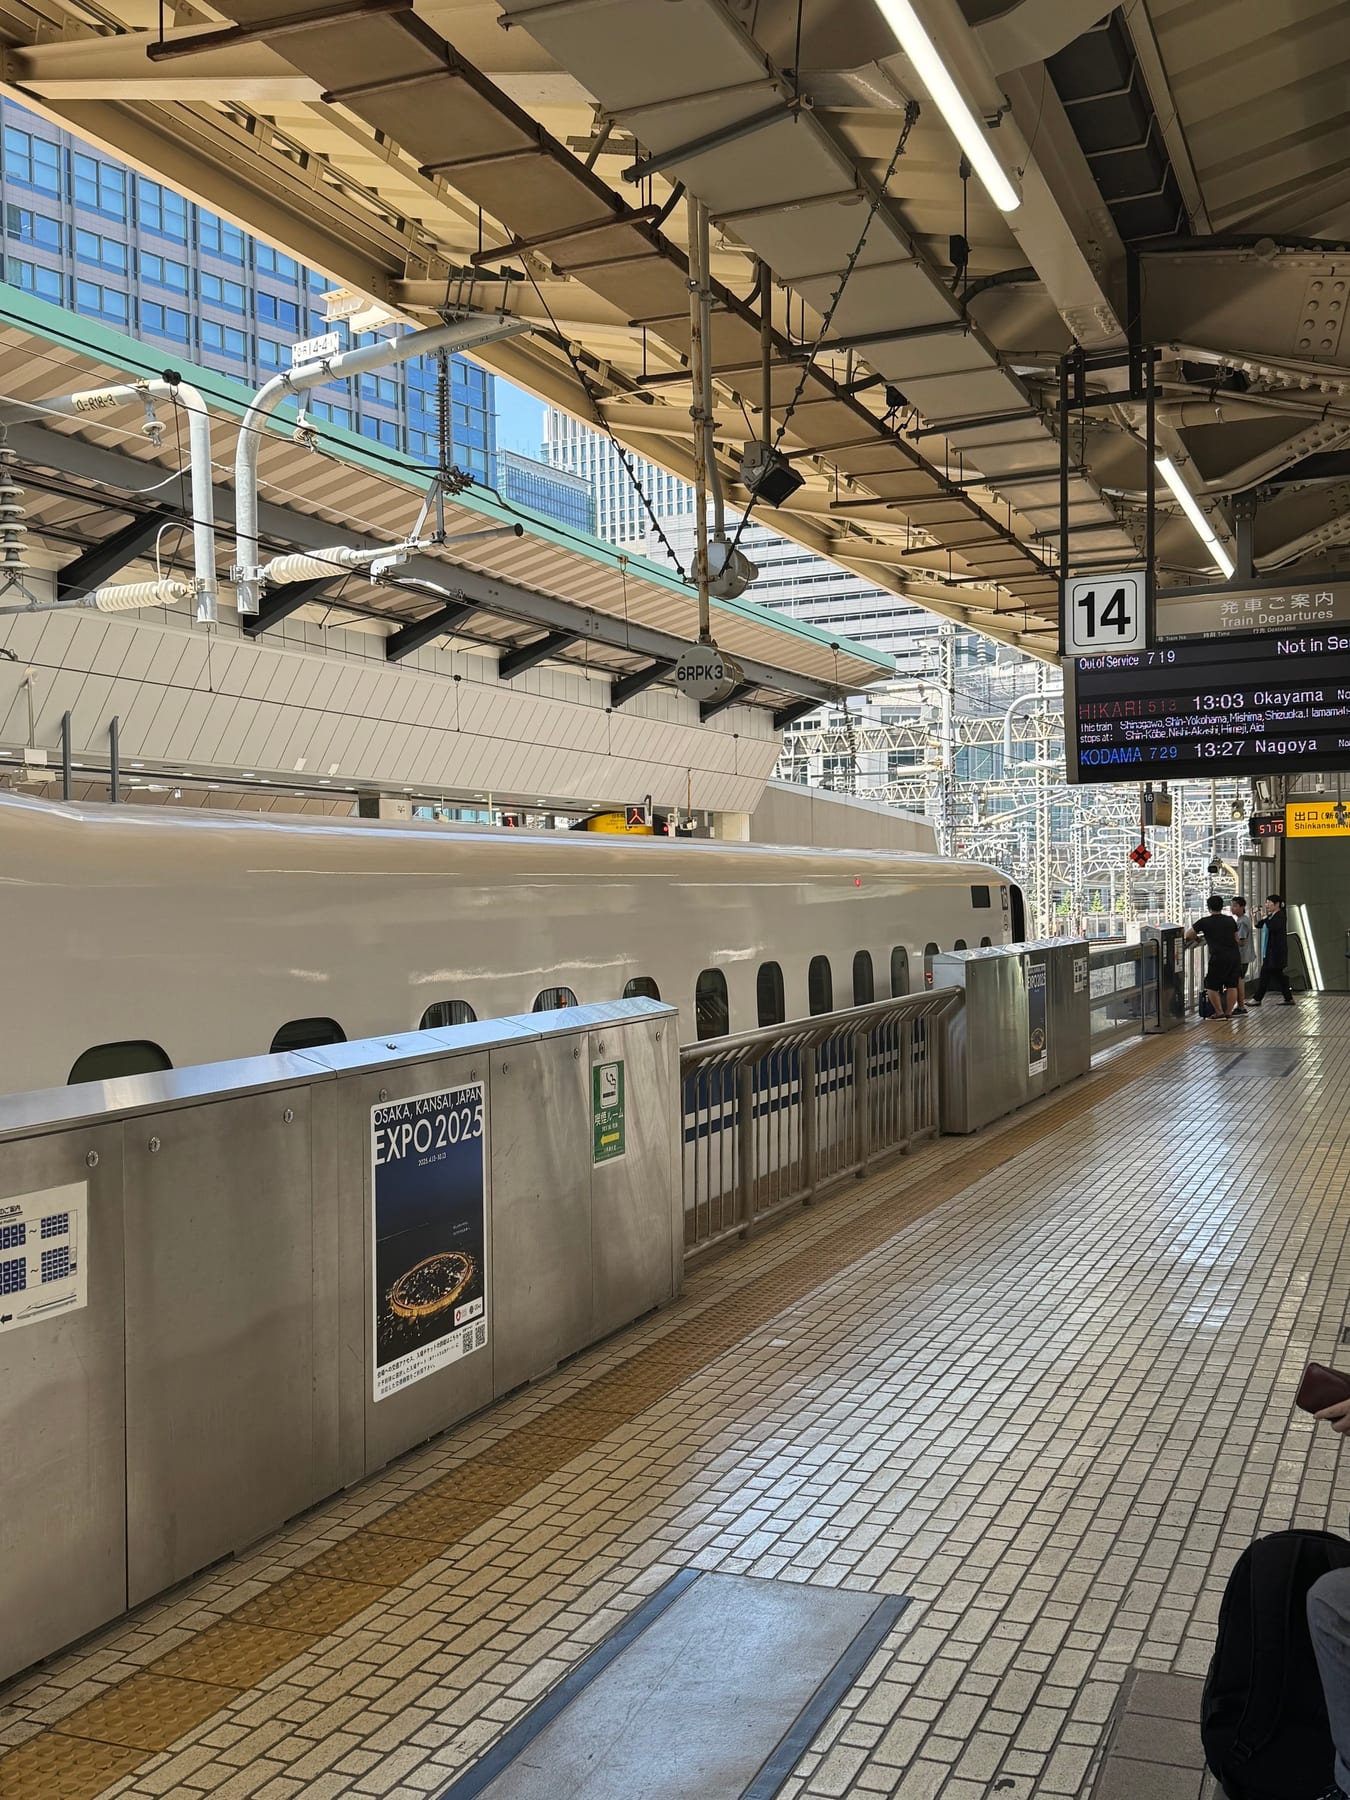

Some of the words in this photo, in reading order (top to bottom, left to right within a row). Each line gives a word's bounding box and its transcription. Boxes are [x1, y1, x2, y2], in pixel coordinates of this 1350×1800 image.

[1078, 588, 1131, 638] 14
[1221, 592, 1334, 614] 発車ご案内
[1220, 616, 1254, 628] Train
[1258, 609, 1334, 625] Departures
[1106, 654, 1139, 668] Service
[1147, 650, 1176, 665] 719
[1277, 639, 1306, 655] Not
[1310, 638, 1323, 652] in
[1327, 636, 1350, 650] Se
[1079, 700, 1142, 719] HIKARI
[1148, 700, 1177, 713] 513
[1193, 693, 1244, 710] 13:03
[1254, 691, 1323, 707] Okayama
[1097, 722, 1112, 731] train
[1080, 734, 1101, 743] stops
[1080, 746, 1143, 765] KODAMA
[1149, 746, 1178, 759] 729
[1193, 740, 1246, 758] 13:27
[1255, 740, 1317, 755] Nagoya
[1144, 794, 1154, 802] 16
[1294, 821, 1339, 830] Shinkansen
[374, 1104, 413, 1126] OSAKA,
[415, 1094, 454, 1117] KANSAI,
[455, 1087, 483, 1106] JAPAN
[374, 1118, 432, 1166] EXPO
[435, 1104, 484, 1148] 2025
